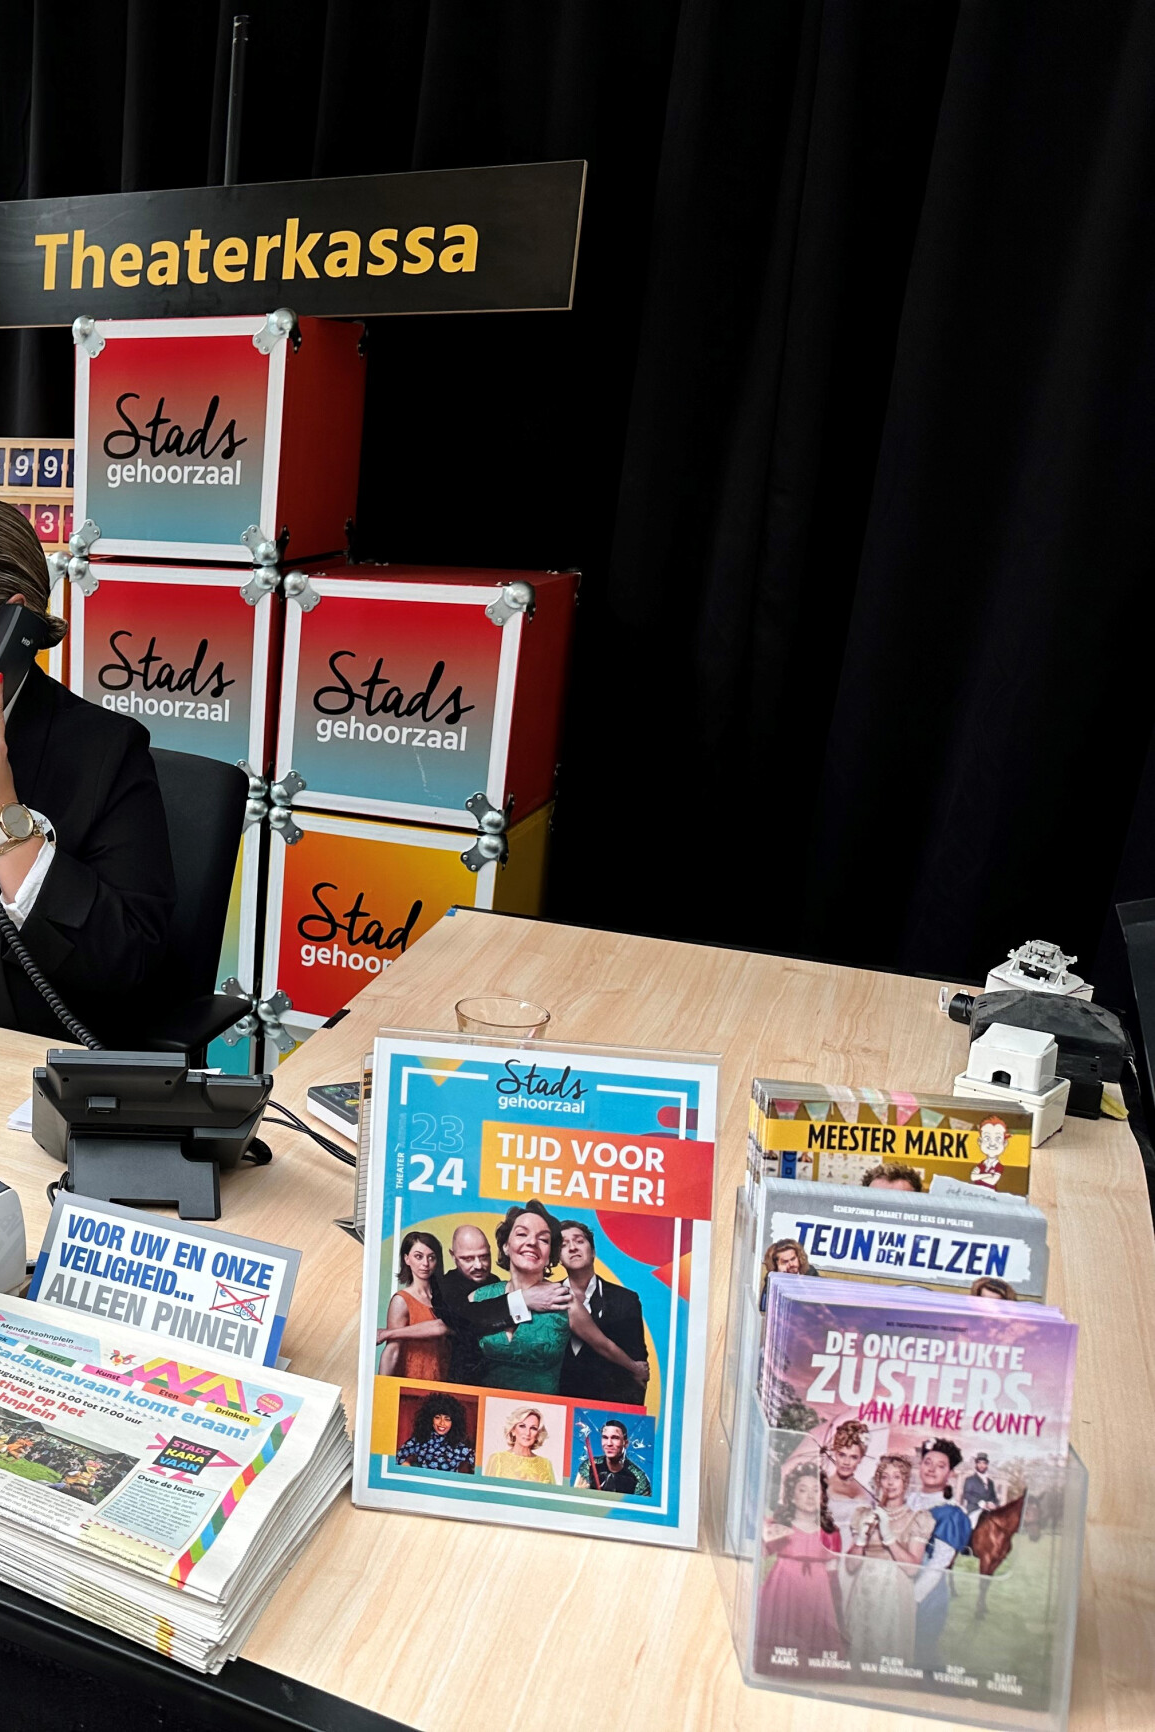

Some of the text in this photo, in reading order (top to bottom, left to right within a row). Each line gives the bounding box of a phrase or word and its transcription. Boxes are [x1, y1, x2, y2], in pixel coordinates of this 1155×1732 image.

[35, 218, 479, 290] Theaterkassa
[103, 392, 248, 460] Stads
[106, 459, 242, 488] gehoorzaal
[98, 630, 235, 698] Stads
[102, 690, 231, 722] gehoorzaal
[313, 650, 476, 725] Stads
[316, 715, 468, 751] gehoorzaal
[297, 882, 423, 954] Stad
[300, 943, 394, 974] gehoor
[496, 1059, 588, 1100] Stads
[497, 1093, 586, 1114] gehoorzaal
[409, 1112, 464, 1153] 23
[497, 1131, 665, 1173] TIJD VOOR
[807, 1123, 970, 1160] MEESTER MARK
[395, 1152, 405, 1190] THEATER
[408, 1153, 467, 1196] 24
[496, 1162, 666, 1208] THEATER!
[68, 1213, 274, 1291] VOOR UW EN ONZE
[795, 1221, 1010, 1278] TEUN VAN DEN ELZEN
[58, 1242, 194, 1302] VEILIGHEID...
[0, 1323, 74, 1344] Mendelssohnplein
[44, 1273, 259, 1359] ALLEEN PINNEN
[35, 1348, 65, 1363] Theater
[825, 1330, 1025, 1371] DE ONGEPLUKTE
[96, 1369, 120, 1381] Kunst
[158, 1389, 179, 1400] Eten
[805, 1353, 1033, 1417] ZUSTERS
[34, 1394, 56, 1408] op
[57, 1402, 87, 1418] het
[38, 1385, 55, 1395] van
[57, 1391, 82, 1404] 13.00
[82, 1399, 98, 1410] tot
[99, 1406, 125, 1419] 17.00
[125, 1416, 143, 1426] uur
[122, 1390, 179, 1417] komt
[181, 1412, 251, 1441] eraan!
[214, 1407, 251, 1423] Drinken
[899, 1403, 964, 1431] ALMERE
[972, 1410, 1046, 1438] COUNTY
[159, 1457, 200, 1473] VAAN
[165, 1448, 205, 1464] KARA
[172, 1439, 213, 1457] STADS
[137, 1474, 205, 1498] Over de locatie
